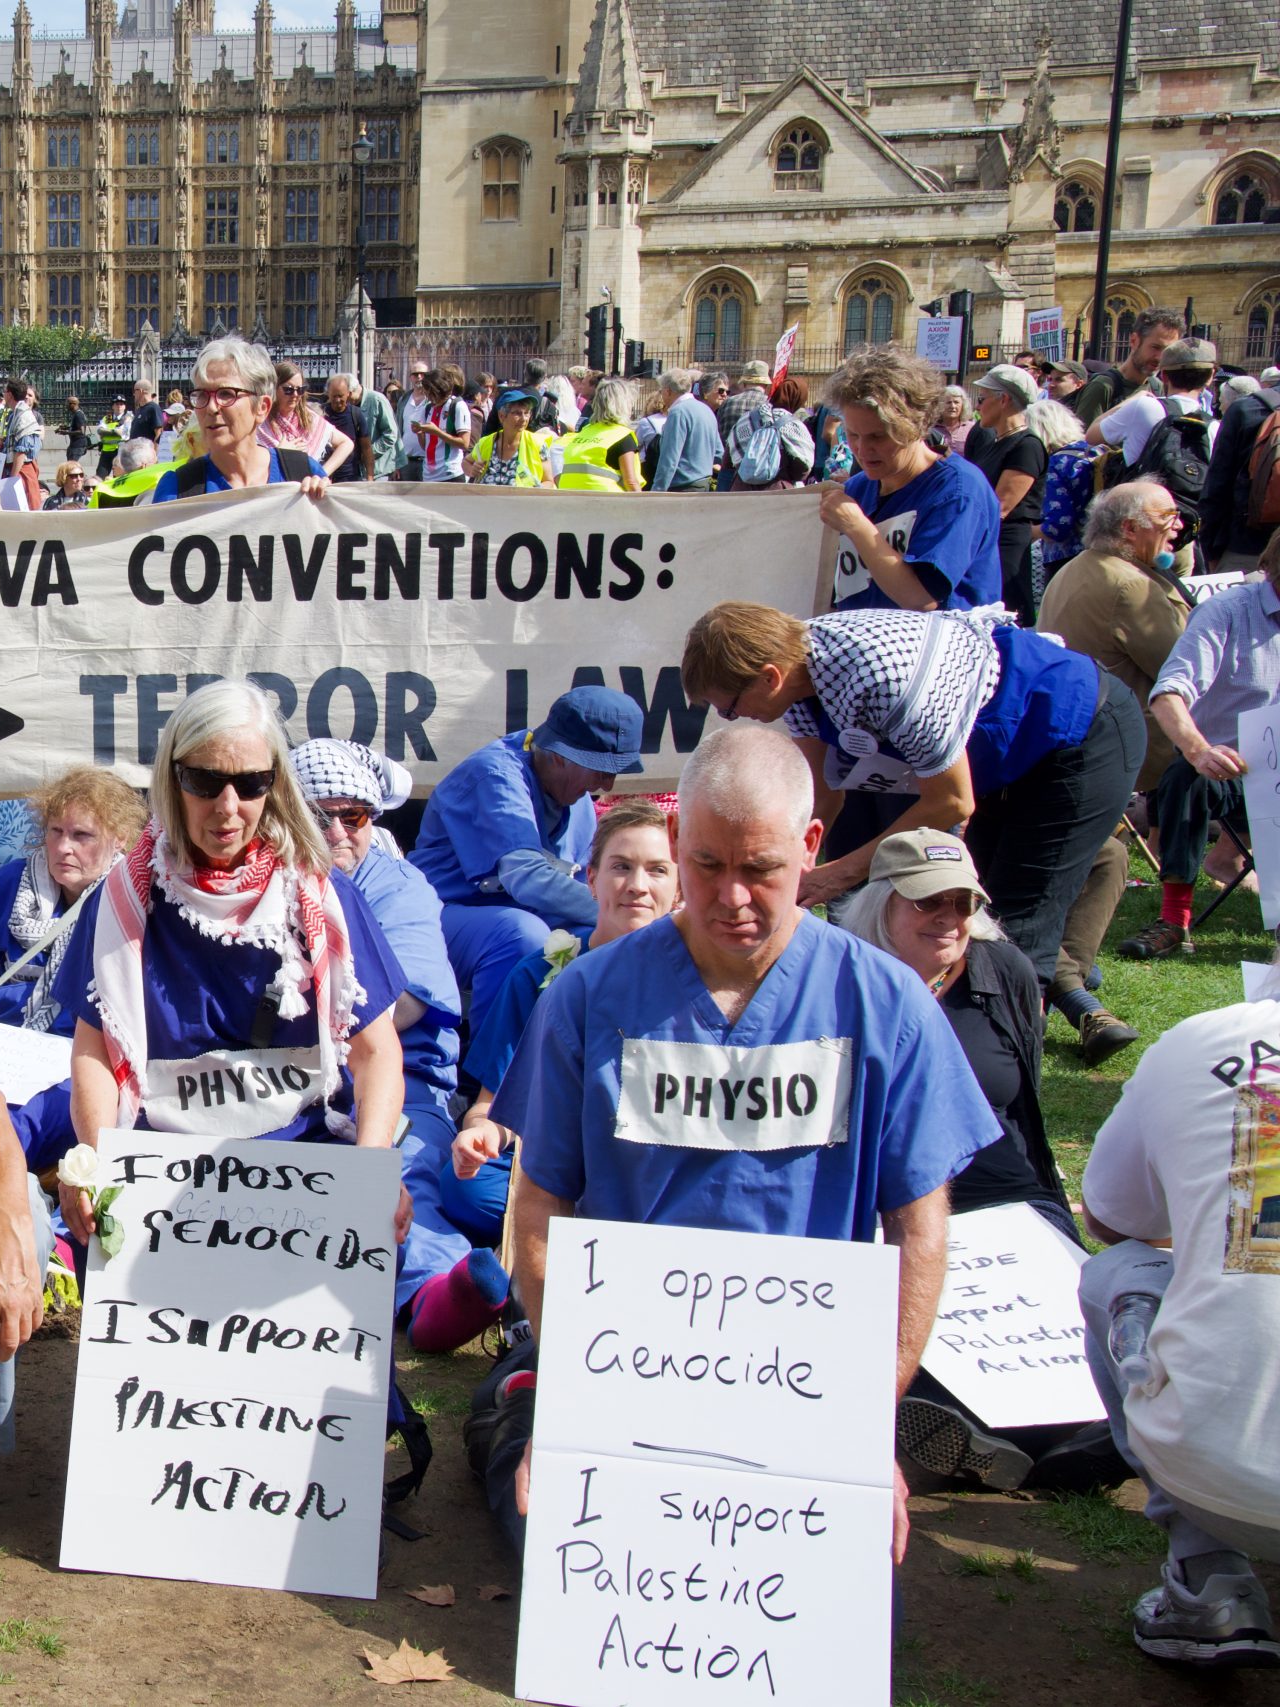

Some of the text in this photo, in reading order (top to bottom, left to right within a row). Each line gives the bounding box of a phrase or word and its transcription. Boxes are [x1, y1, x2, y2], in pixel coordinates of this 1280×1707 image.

[976, 348, 989, 359] 02
[1031, 333, 1049, 349] DEFEND
[1050, 330, 1059, 346] THE
[128, 532, 676, 606] CONVENTIONS:
[177, 1066, 311, 1111] PHYSIO
[654, 1072, 818, 1121] PHYSIO
[113, 1154, 336, 1196] I OPPOSE
[143, 1209, 391, 1273] GENOCIDE
[584, 1239, 835, 1331] I oppose
[88, 1299, 138, 1345] I
[585, 1330, 823, 1399] Genocide
[151, 1460, 346, 1522] ACTION
[572, 1467, 828, 1546] I support
[556, 1540, 797, 1622] Palestine
[598, 1614, 776, 1697] Action
